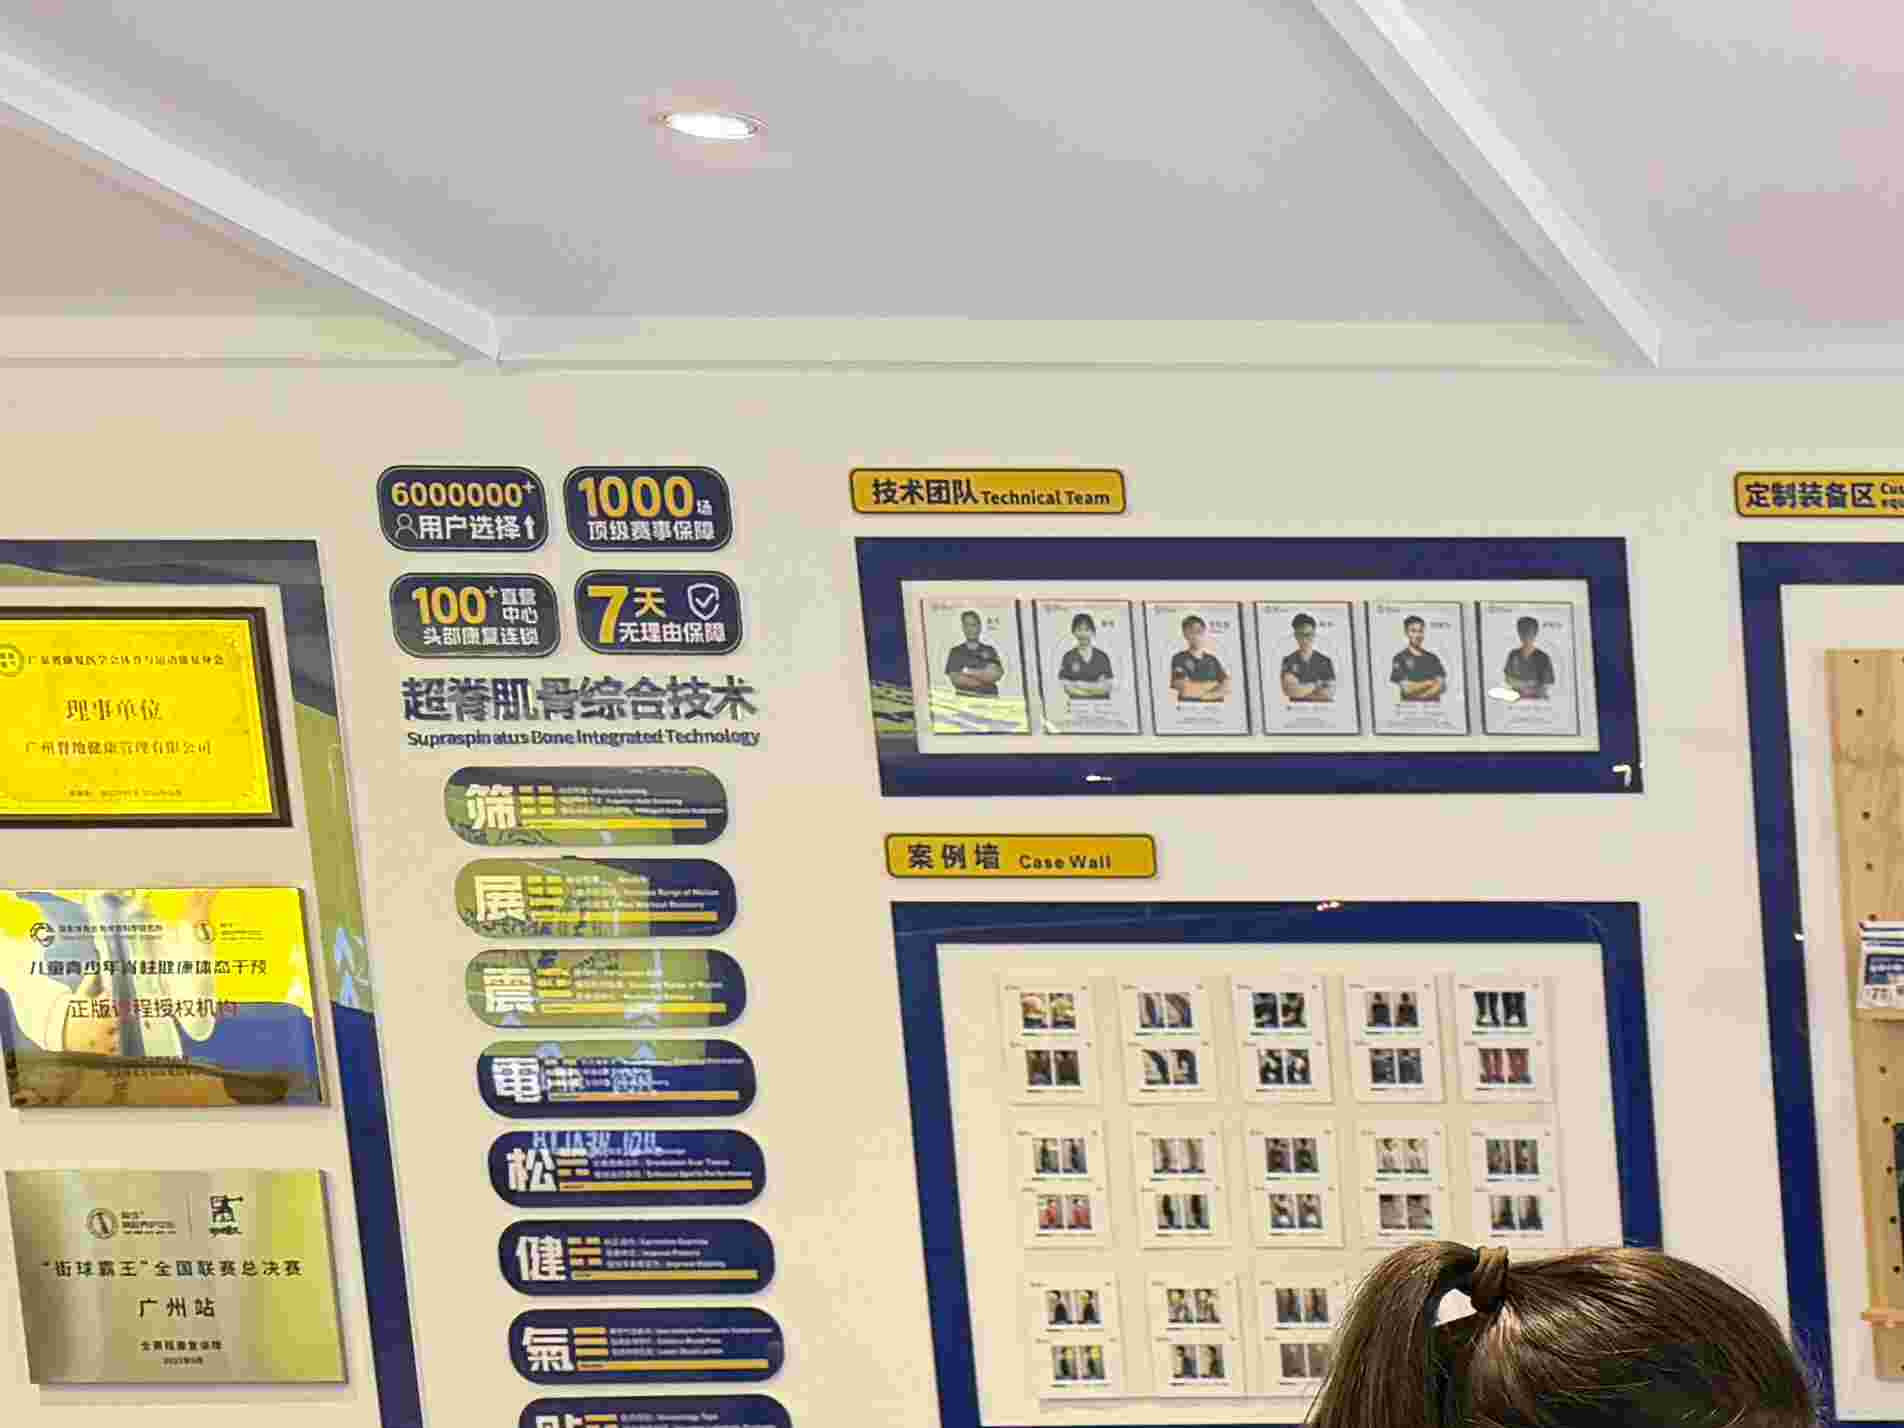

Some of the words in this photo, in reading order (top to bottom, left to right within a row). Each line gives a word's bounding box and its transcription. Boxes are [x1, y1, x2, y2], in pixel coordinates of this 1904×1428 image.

[872, 478, 979, 505] 技术团队
[980, 490, 1061, 505] Technical
[1065, 490, 1111, 505] Team
[1745, 481, 1876, 509] 定制装备区
[418, 515, 521, 540] 用户选择
[588, 521, 716, 542] 顶级赛事保障
[412, 584, 498, 625] 100+
[502, 605, 538, 625] 中心
[619, 622, 726, 644] 无理由保障
[65, 698, 163, 721] 理事单位
[532, 730, 575, 746] Bone
[577, 730, 664, 748] Integrated
[666, 729, 760, 748] Technology
[908, 843, 1000, 870] 案例墙
[1019, 854, 1065, 870] Case
[1069, 854, 1112, 870] Wall
[506, 1147, 559, 1193] 松
[516, 1235, 568, 1281] 健
[138, 1296, 217, 1319] 广州站
